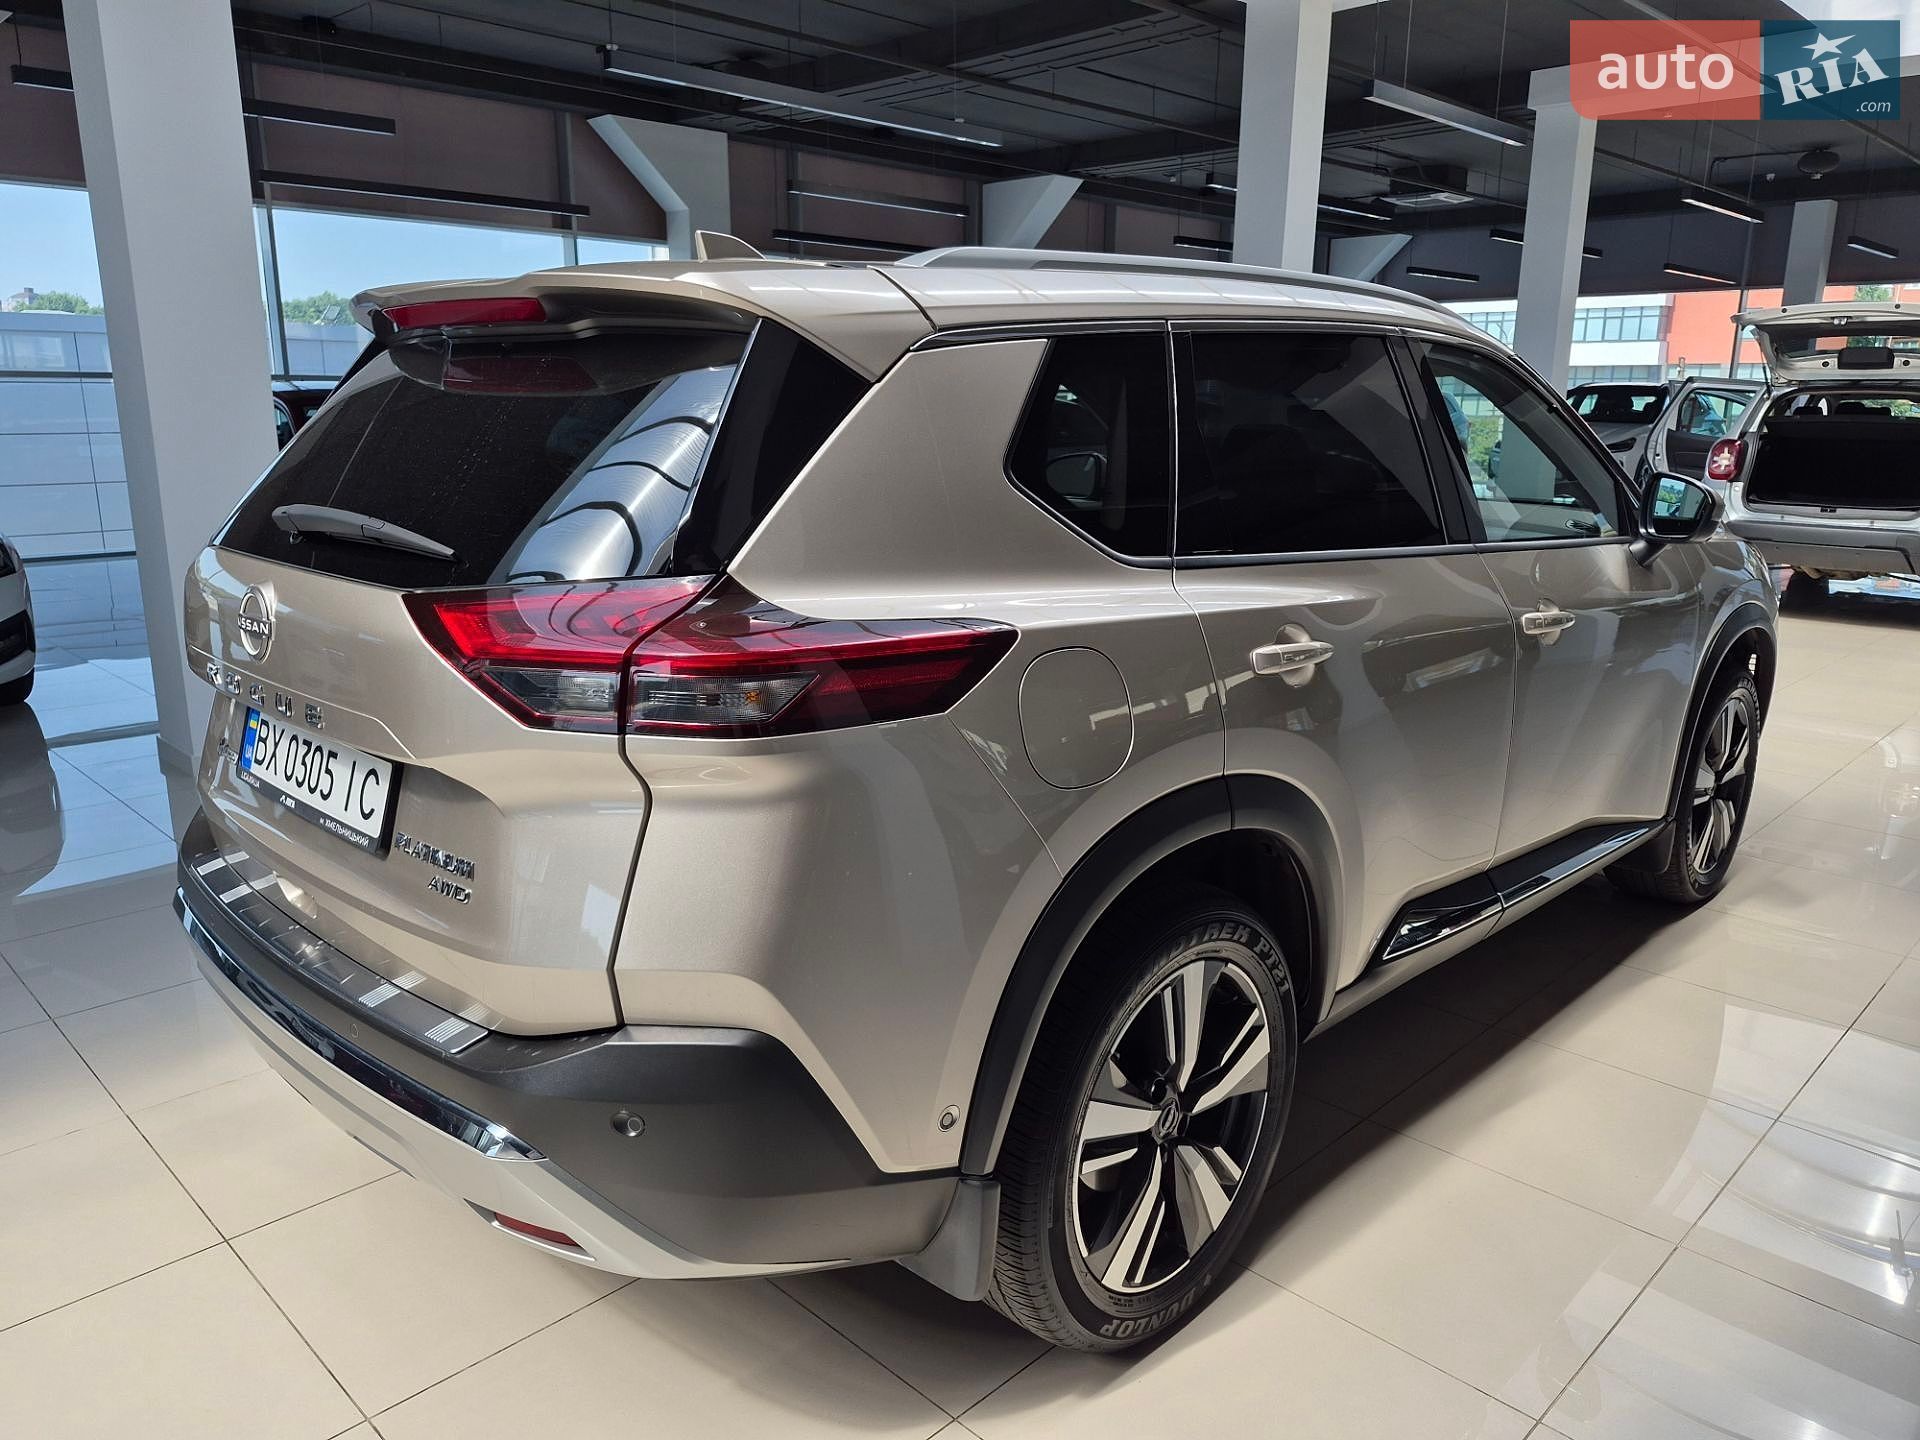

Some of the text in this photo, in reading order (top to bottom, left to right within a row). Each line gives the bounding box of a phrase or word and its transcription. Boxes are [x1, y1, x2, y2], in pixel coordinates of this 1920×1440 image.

[254, 718, 285, 777] BX
[284, 734, 338, 801] 0305
[344, 760, 380, 821] IC
[395, 832, 475, 882] PLATINUM
[427, 875, 472, 904] AWD
[1252, 936, 1290, 994] PT21
[1100, 1287, 1196, 1339] DUNLOP
